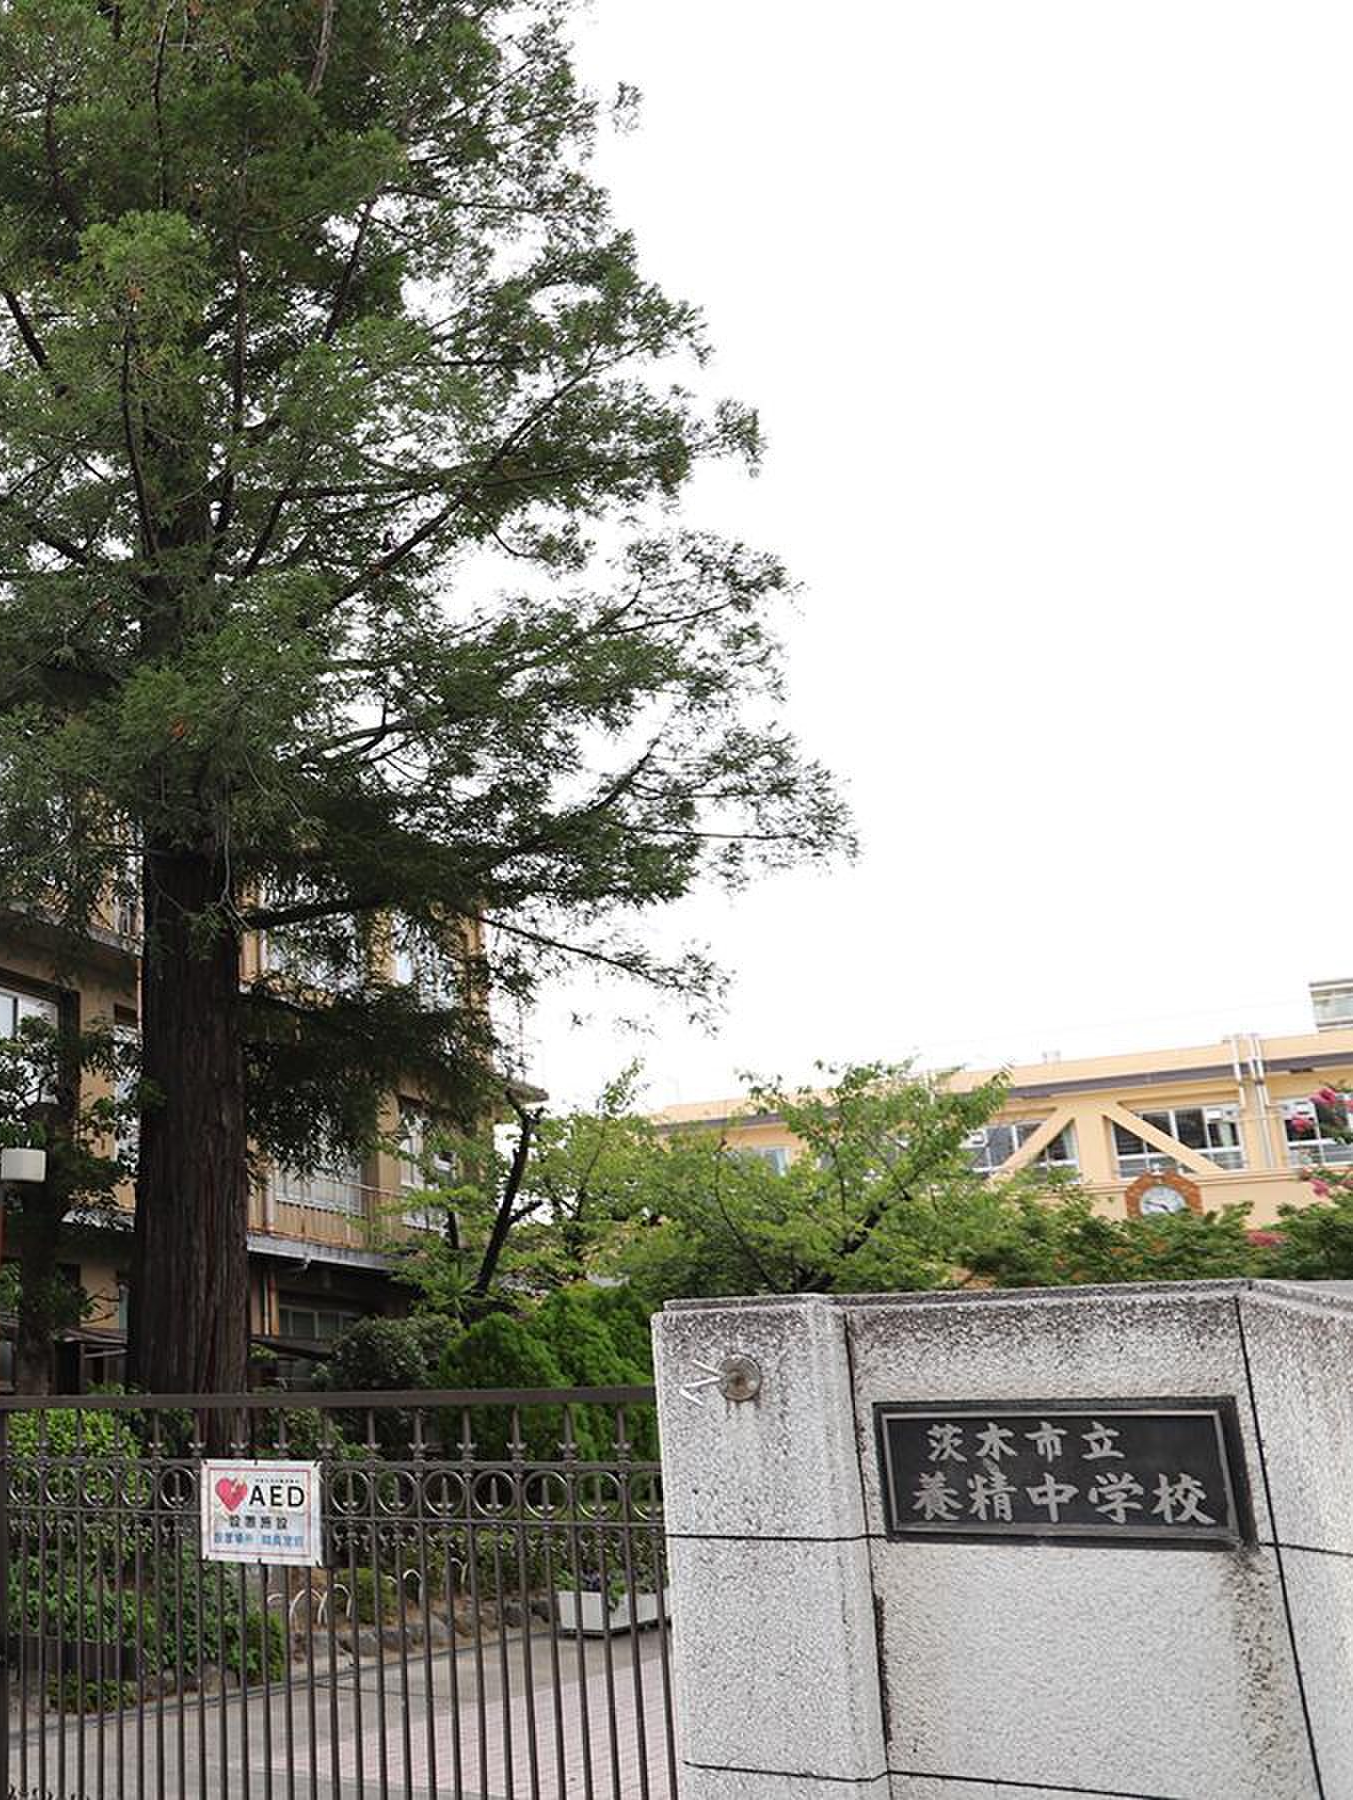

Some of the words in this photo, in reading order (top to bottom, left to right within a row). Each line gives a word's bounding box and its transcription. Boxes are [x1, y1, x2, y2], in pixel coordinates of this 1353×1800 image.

[926, 1420, 1126, 1464] 茨木市立
[249, 1485, 305, 1508] AED
[911, 1464, 1218, 1525] 養精中学校
